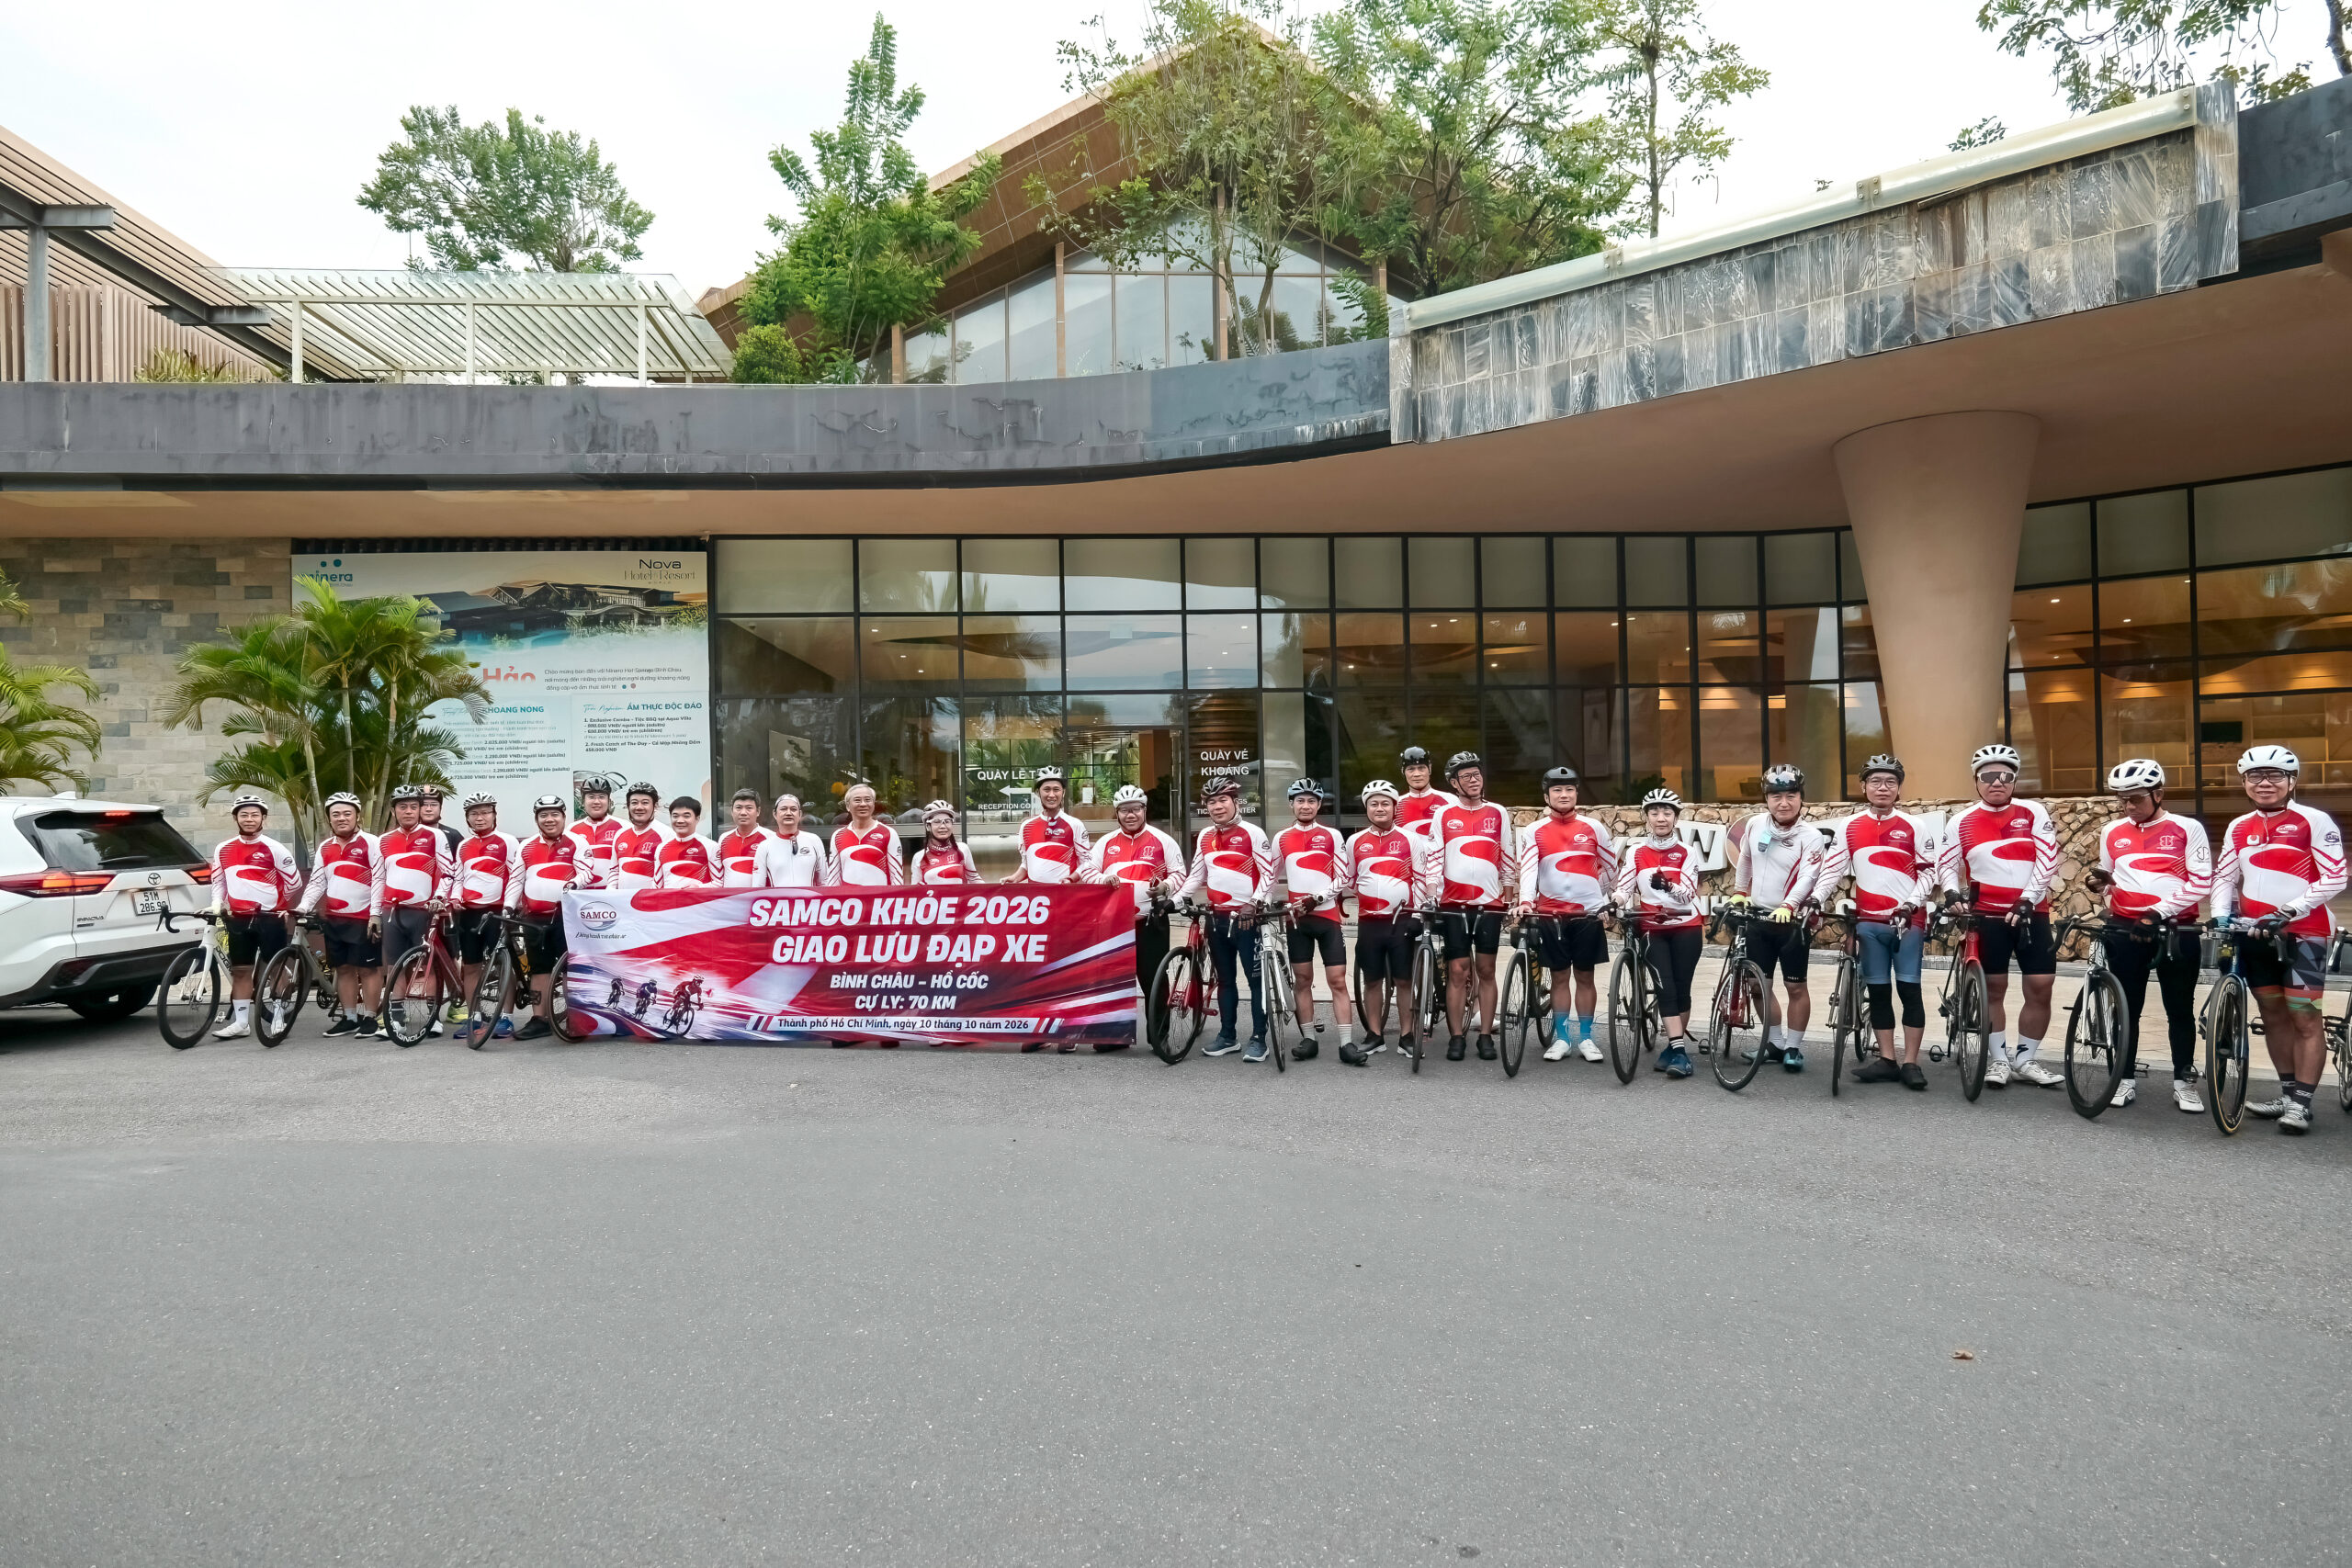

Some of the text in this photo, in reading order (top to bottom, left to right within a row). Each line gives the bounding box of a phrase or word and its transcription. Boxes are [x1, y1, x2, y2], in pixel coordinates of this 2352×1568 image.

[639, 559, 682, 570] Nova
[625, 570, 652, 580] Hotel
[660, 570, 696, 580] Resort
[1234, 748, 1250, 760] VÉ
[1201, 764, 1250, 776] KHOÁNG
[143, 891, 160, 901] 51M
[749, 890, 1050, 926] SAMCO KHỎE 2026
[580, 911, 616, 919] SAMCO
[772, 931, 1048, 968] GIAO LƯU ĐẠP XE
[830, 972, 867, 988] BÌNH
[870, 973, 915, 988] CHÂU
[930, 969, 954, 988] HỒ
[956, 970, 989, 989] CỐC
[854, 993, 957, 1011] CỰ LY: 70 KM
[778, 1017, 1029, 1032] Thành phố Hồ Chí Minh, ngày 10 tháng 10 năm 2026
